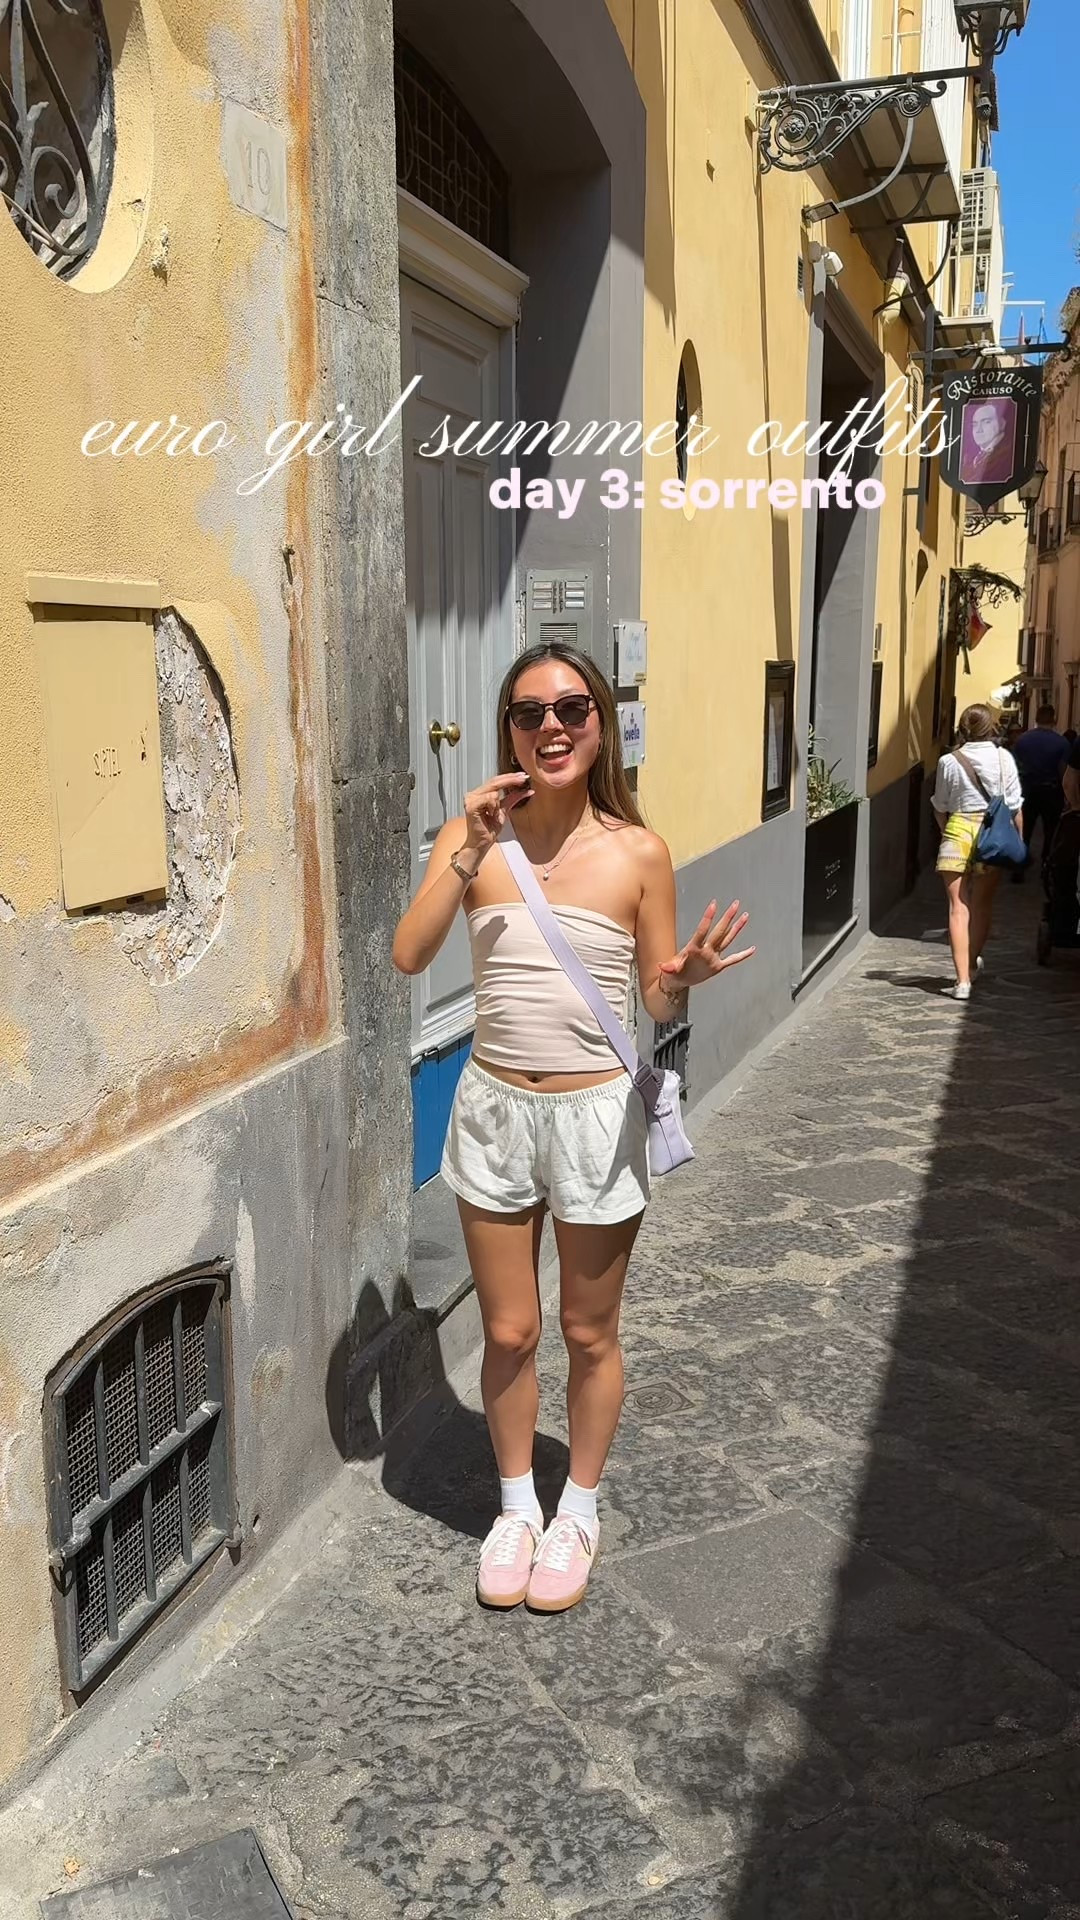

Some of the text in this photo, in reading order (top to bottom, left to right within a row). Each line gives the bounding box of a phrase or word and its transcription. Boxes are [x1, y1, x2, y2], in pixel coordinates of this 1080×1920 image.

[245, 141, 272, 196] 10
[947, 371, 1037, 401] Ristorante
[972, 386, 1013, 396] CARUSO
